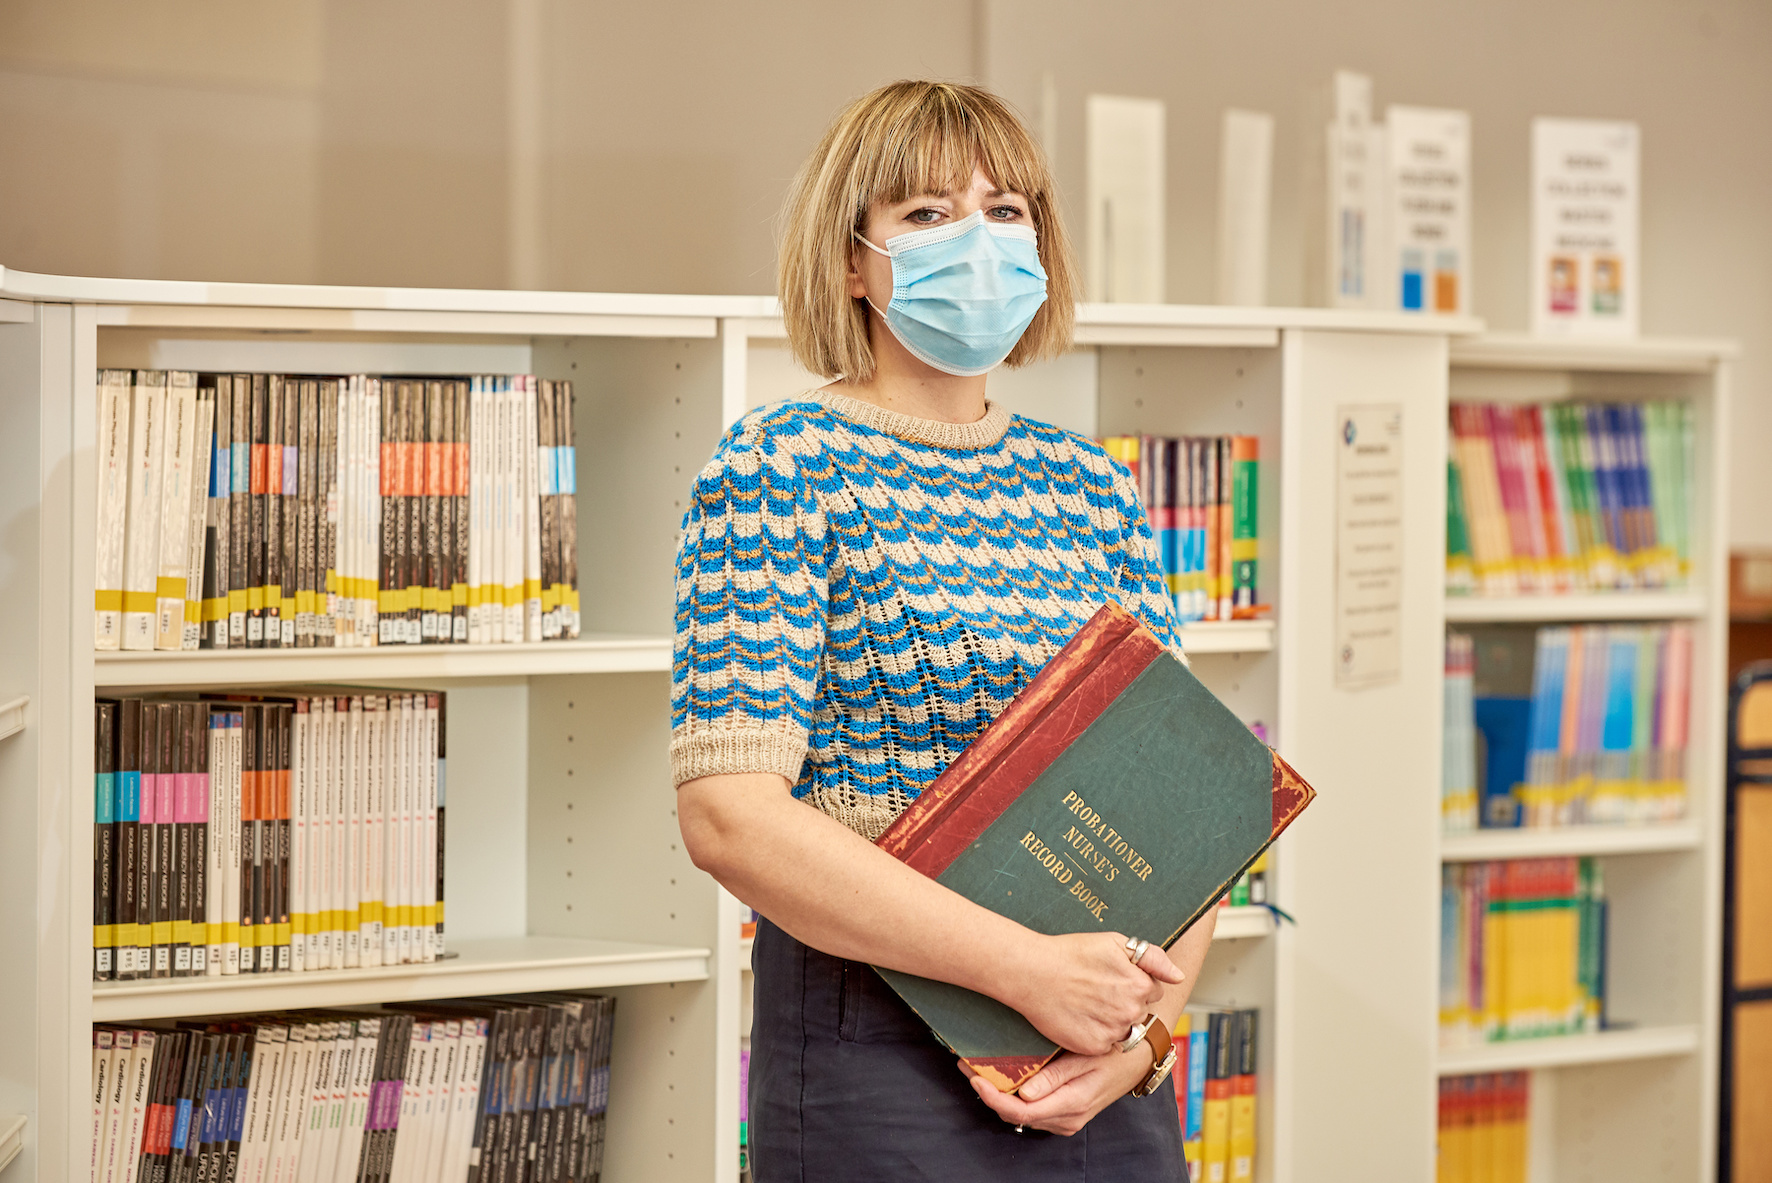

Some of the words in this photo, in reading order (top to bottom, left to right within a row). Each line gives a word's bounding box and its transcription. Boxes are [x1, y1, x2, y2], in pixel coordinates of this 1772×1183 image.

[411, 498, 419, 555] ONCOLOGY
[427, 497, 435, 555] ONCOLOGY
[1062, 790, 1152, 882] PROBATIONER
[1062, 825, 1120, 882] NURSE'S
[1020, 830, 1073, 884] RECORD
[1070, 880, 1109, 922] BOOK.
[96, 1059, 106, 1104] Cardiology
[114, 1059, 126, 1103] Cardiology
[135, 1058, 147, 1102] Cardiology
